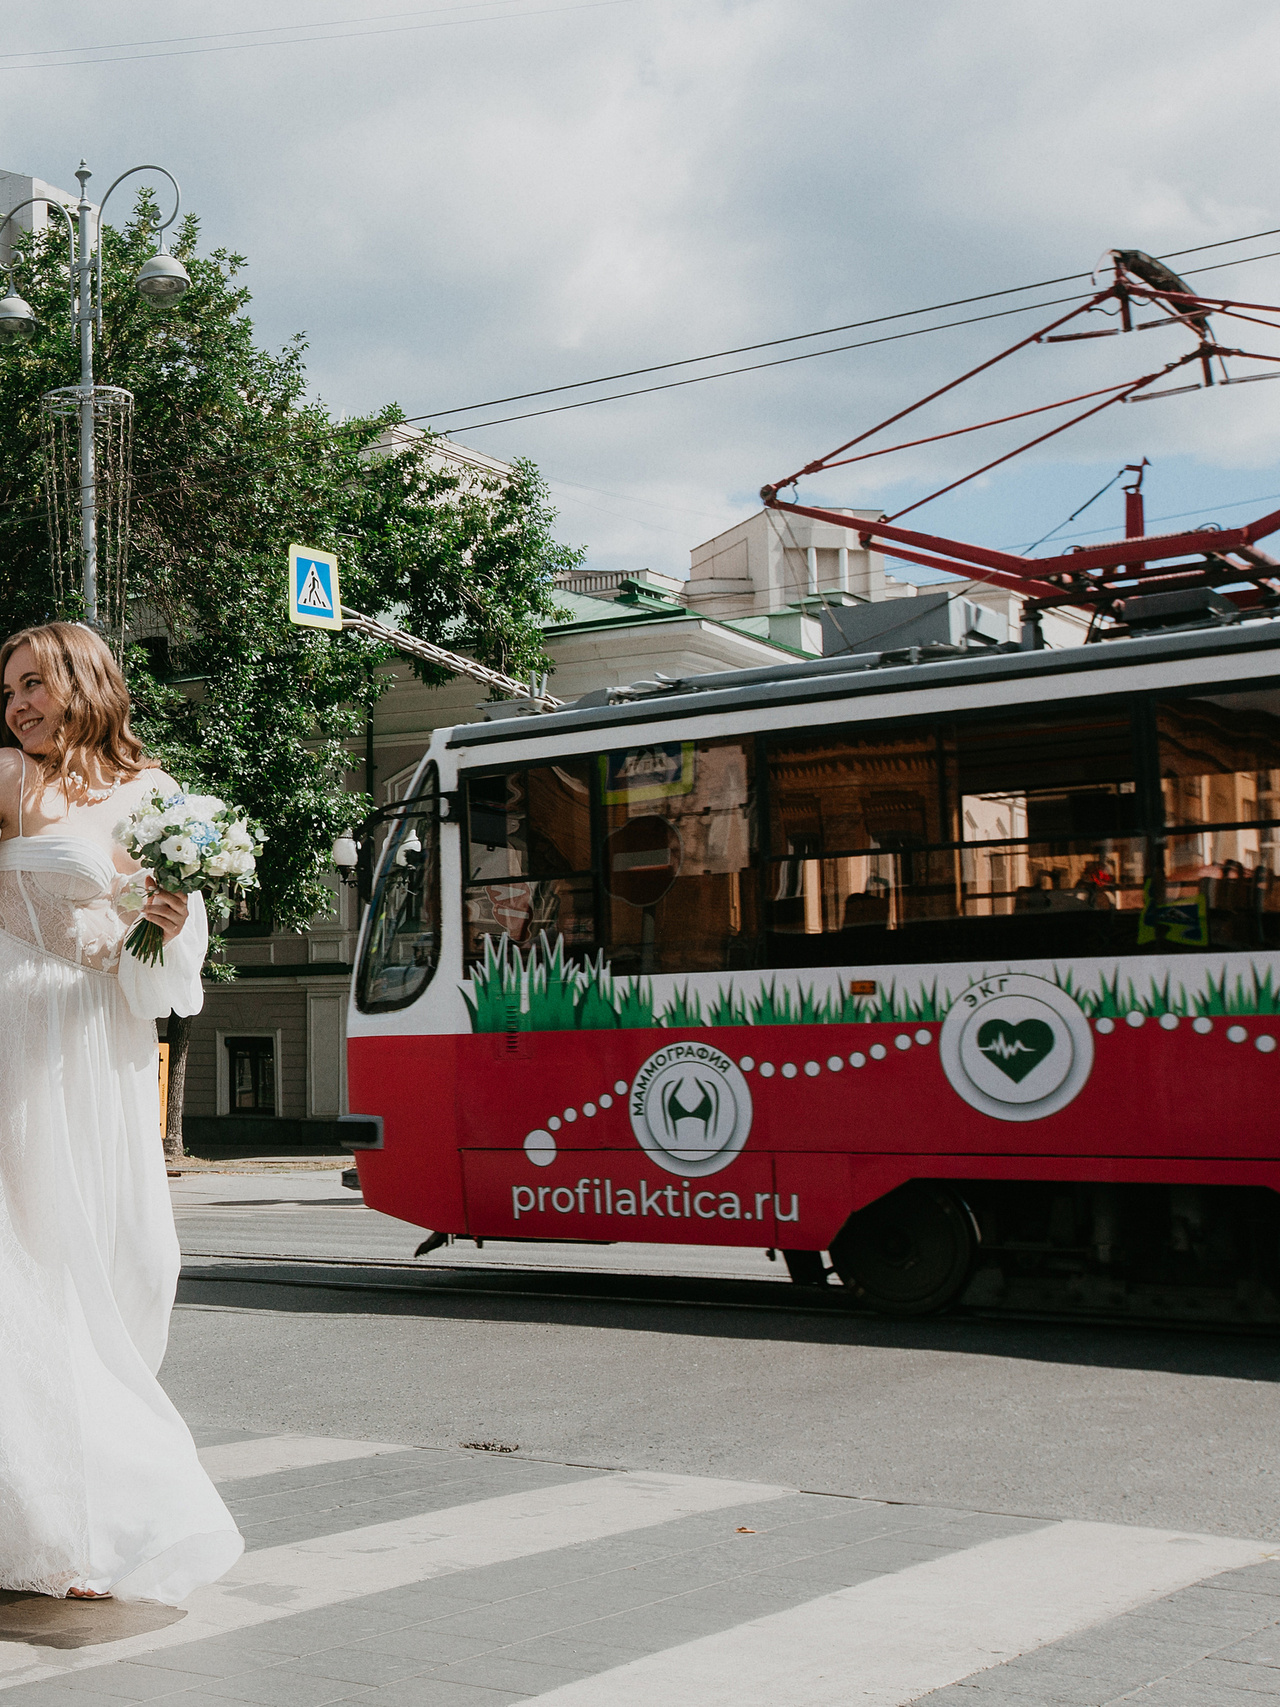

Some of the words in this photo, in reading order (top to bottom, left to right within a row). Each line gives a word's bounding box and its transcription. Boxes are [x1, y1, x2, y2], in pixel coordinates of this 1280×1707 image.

[963, 978, 1009, 1008] ЭКГ
[632, 1045, 732, 1117] МАММОГРАФИЯ
[511, 1177, 800, 1222] profilaktica.ru
